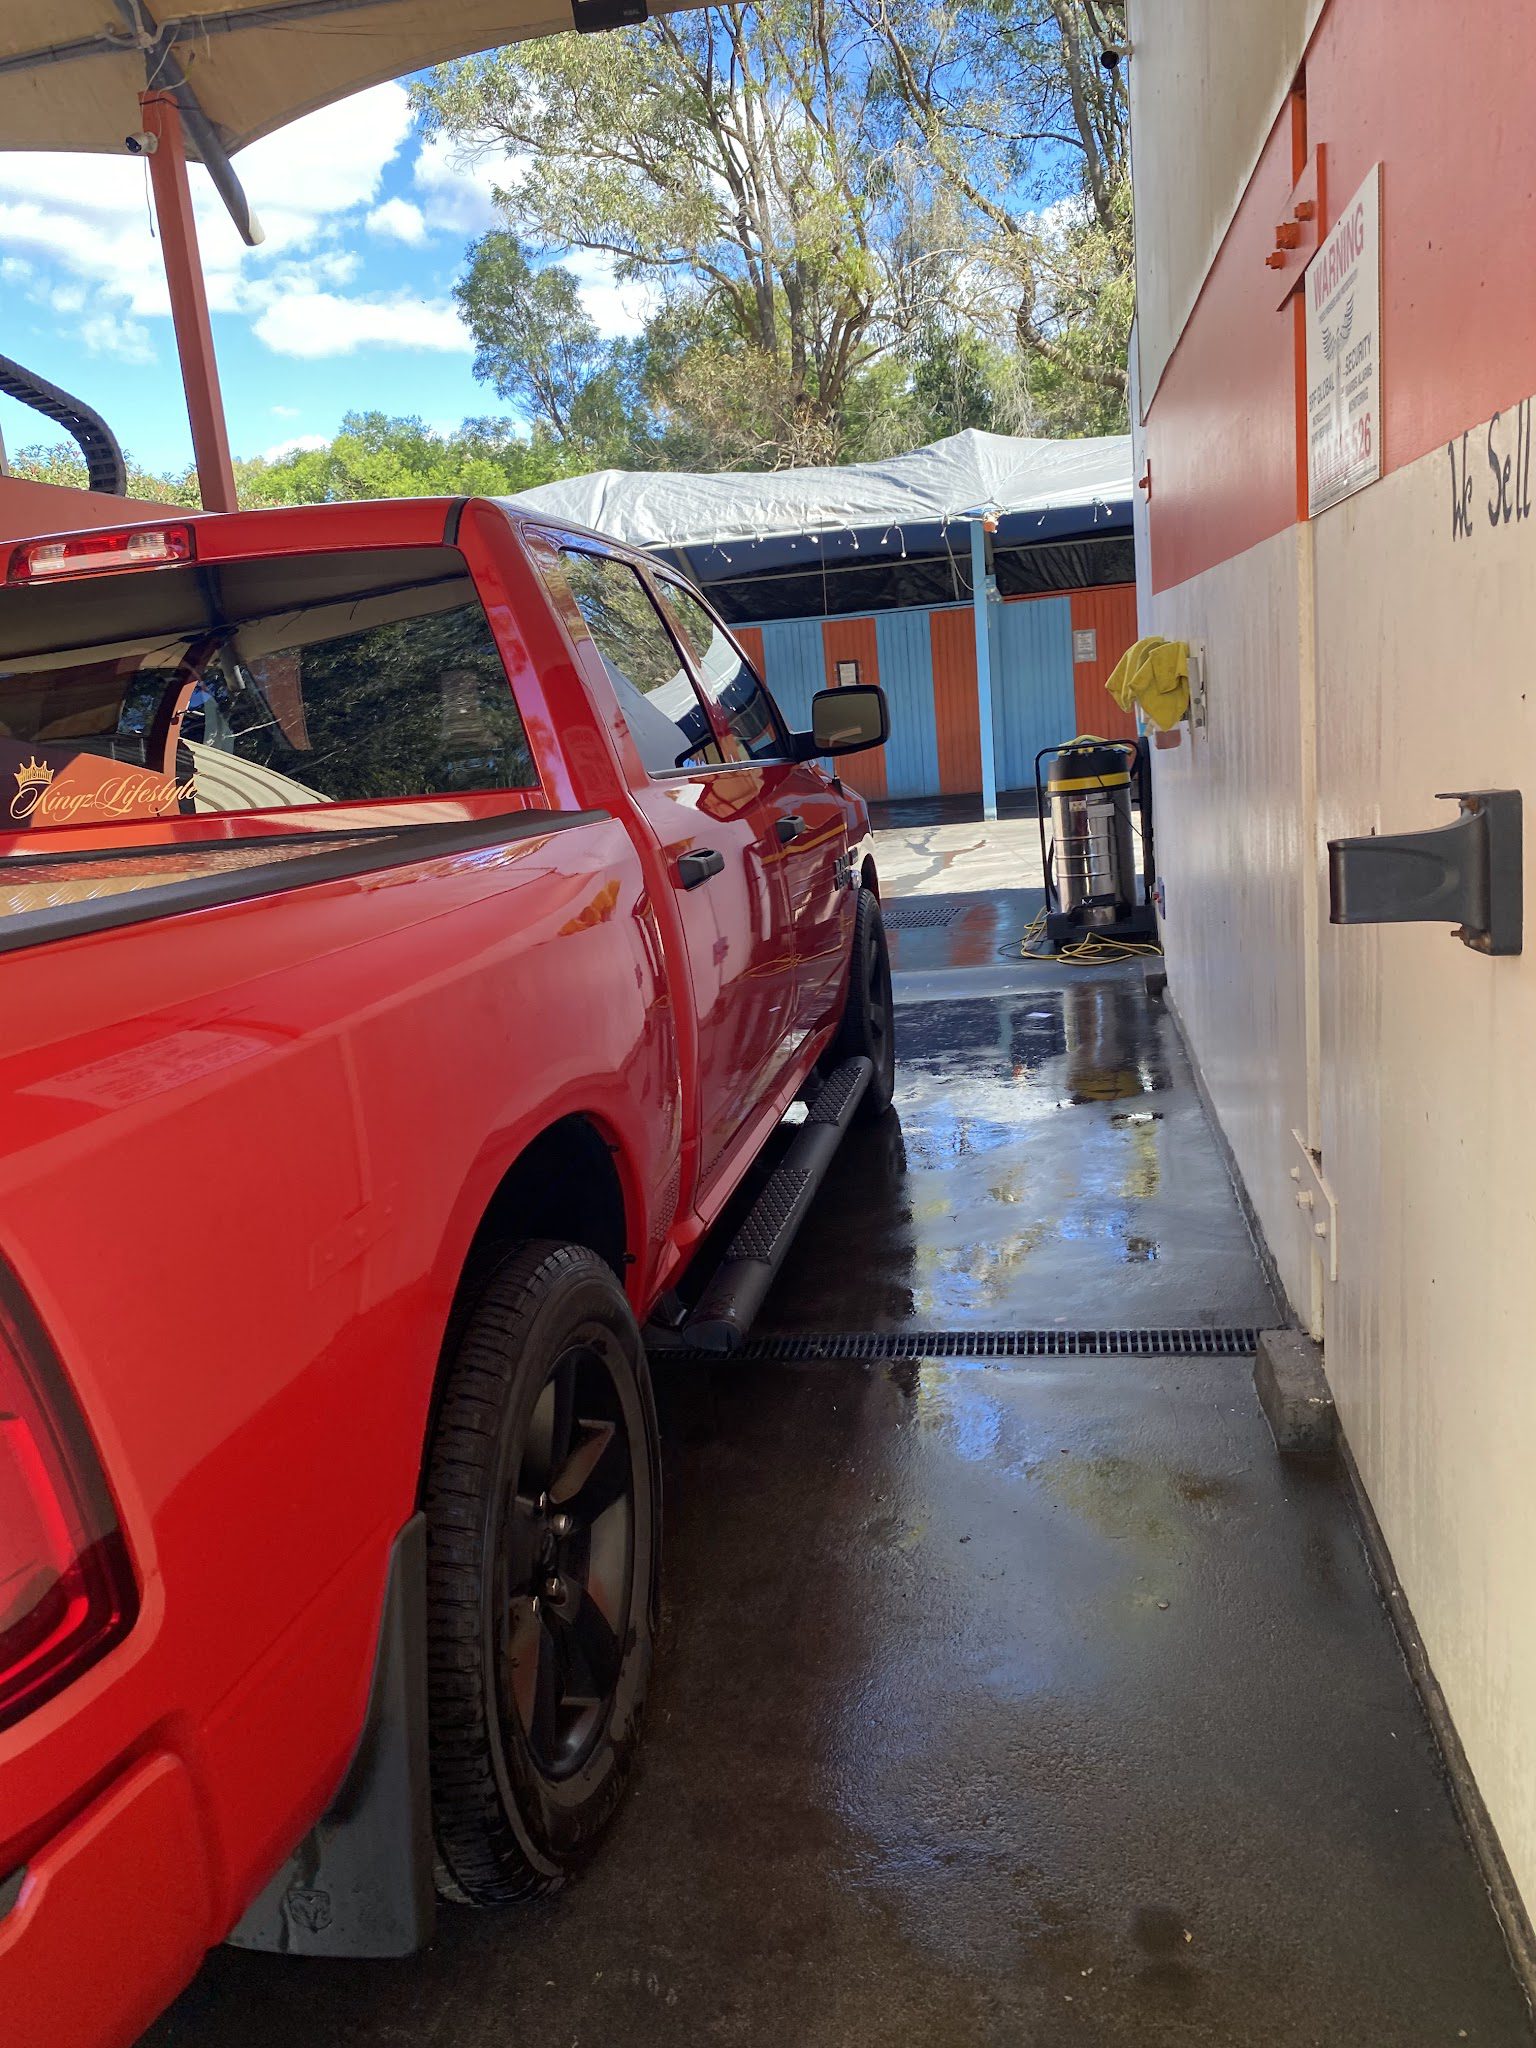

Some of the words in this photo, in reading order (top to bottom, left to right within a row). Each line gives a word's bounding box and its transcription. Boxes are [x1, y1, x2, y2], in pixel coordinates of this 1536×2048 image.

[1313, 201, 1364, 312] WARNING
[1345, 330, 1371, 377] SECURITY
[1448, 430, 1473, 542] We
[1488, 397, 1531, 527] Sell
[10, 779, 96, 822] Kingz
[92, 774, 197, 817] Lifestyle
